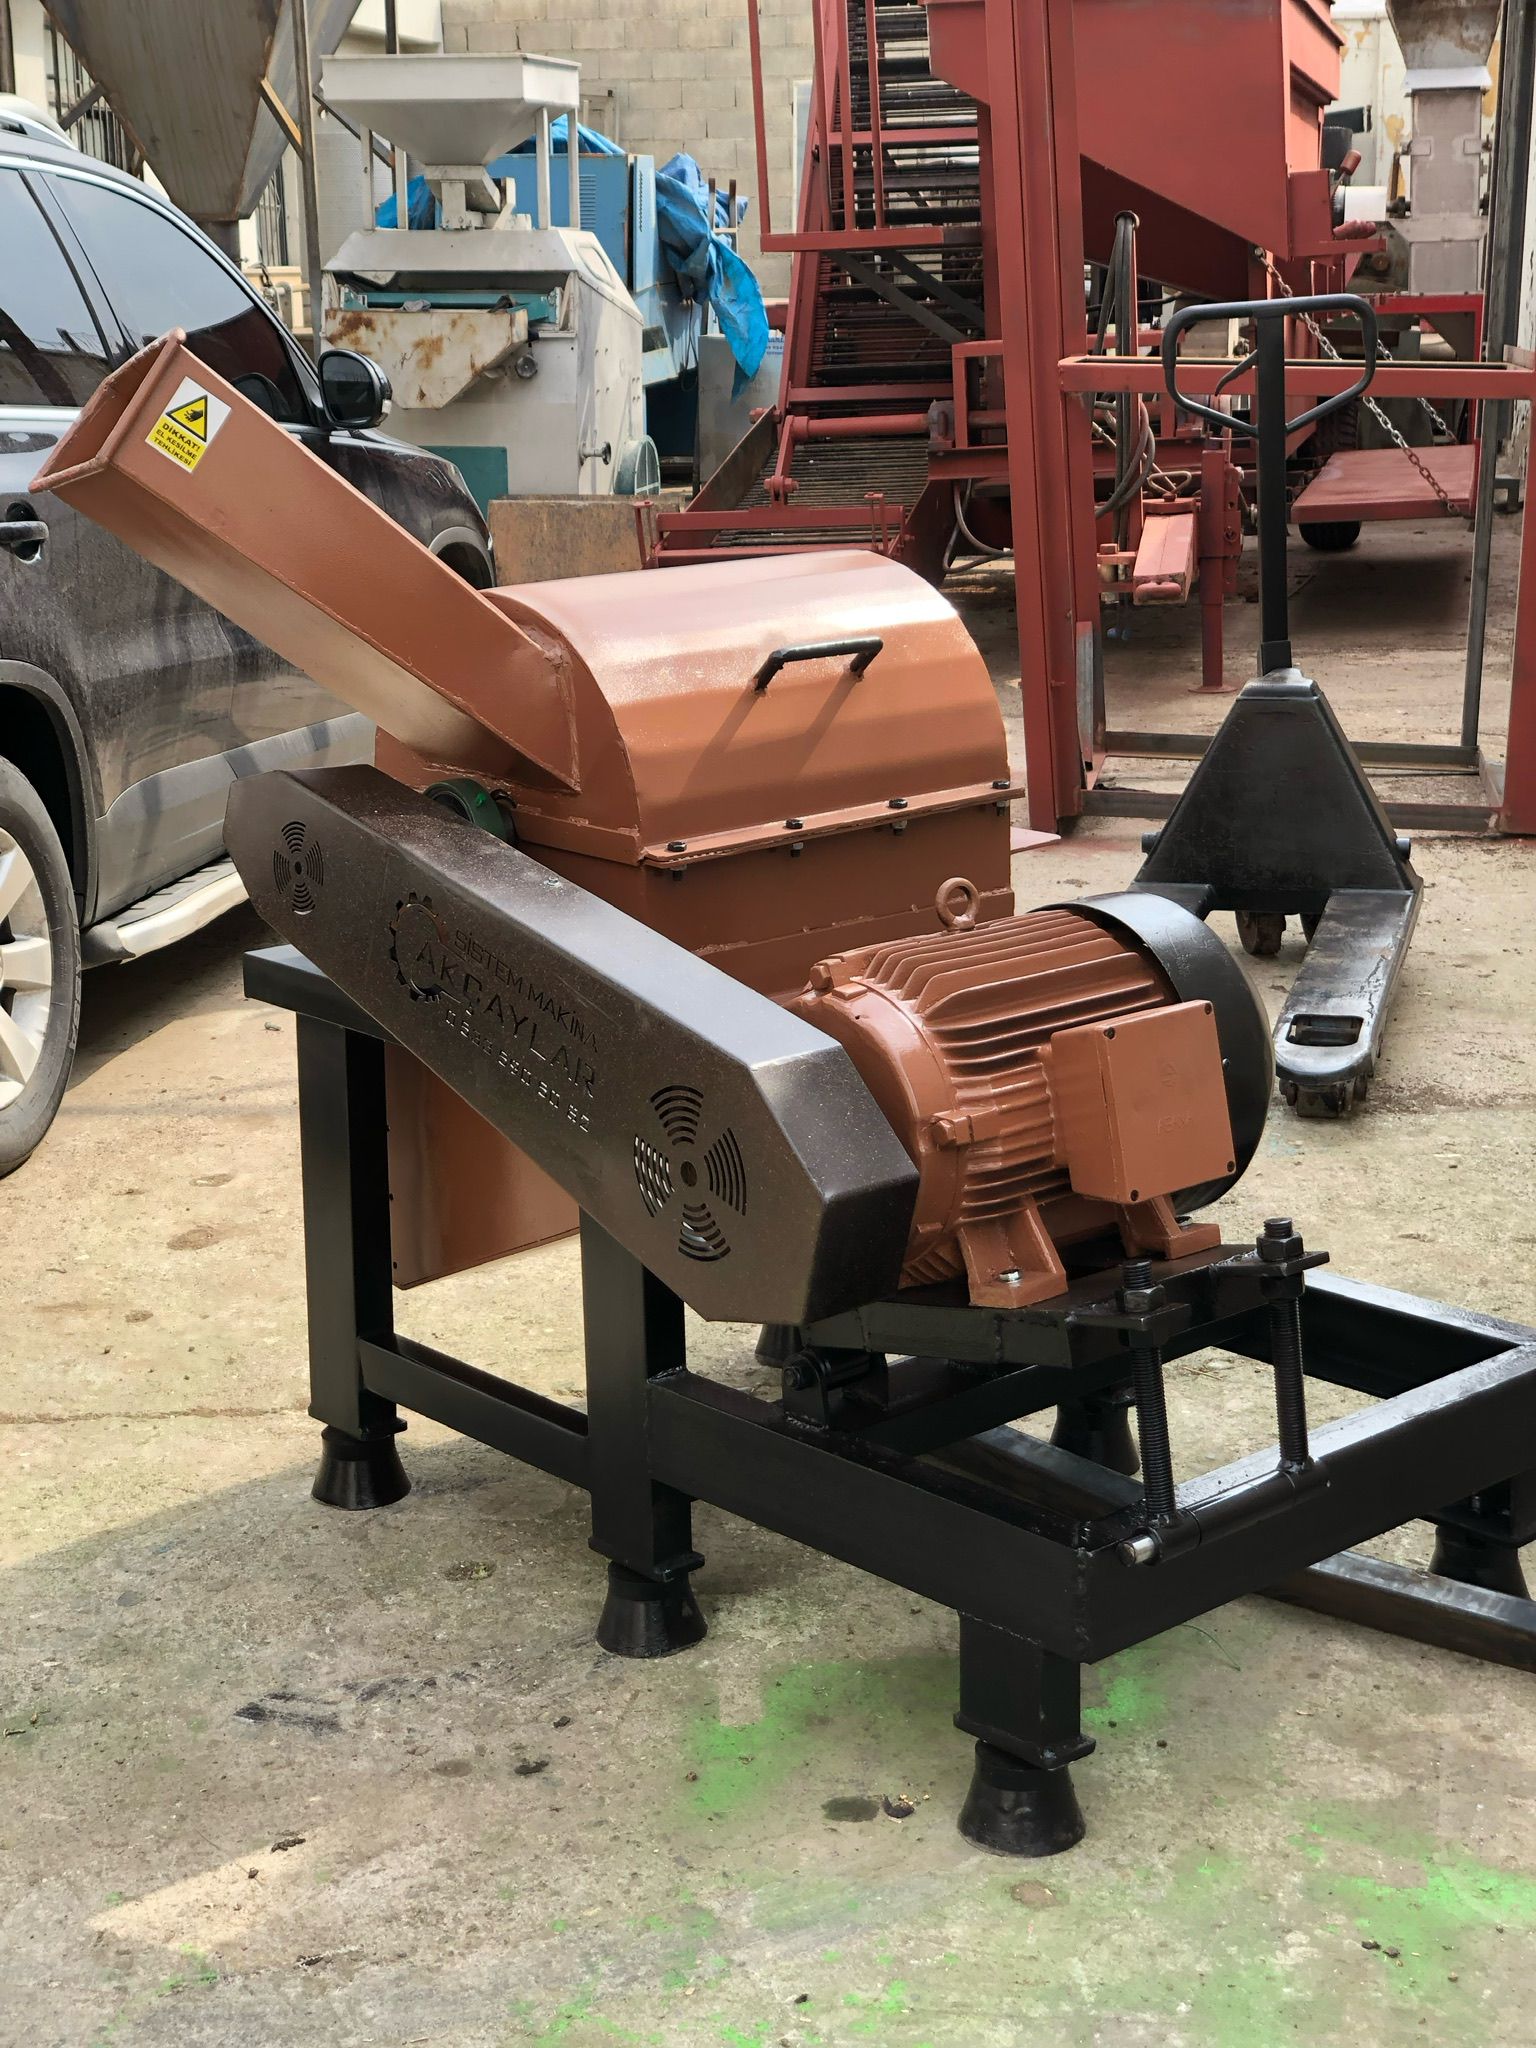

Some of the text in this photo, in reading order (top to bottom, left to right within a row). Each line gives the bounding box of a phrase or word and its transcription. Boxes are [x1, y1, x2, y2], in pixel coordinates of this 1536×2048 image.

[156, 429, 197, 460] EL KESİLME
[162, 422, 201, 451] DİKKAT!
[416, 941, 595, 1099] AKÇAYLAR
[454, 928, 598, 1053] SİSTEM MAKİNA
